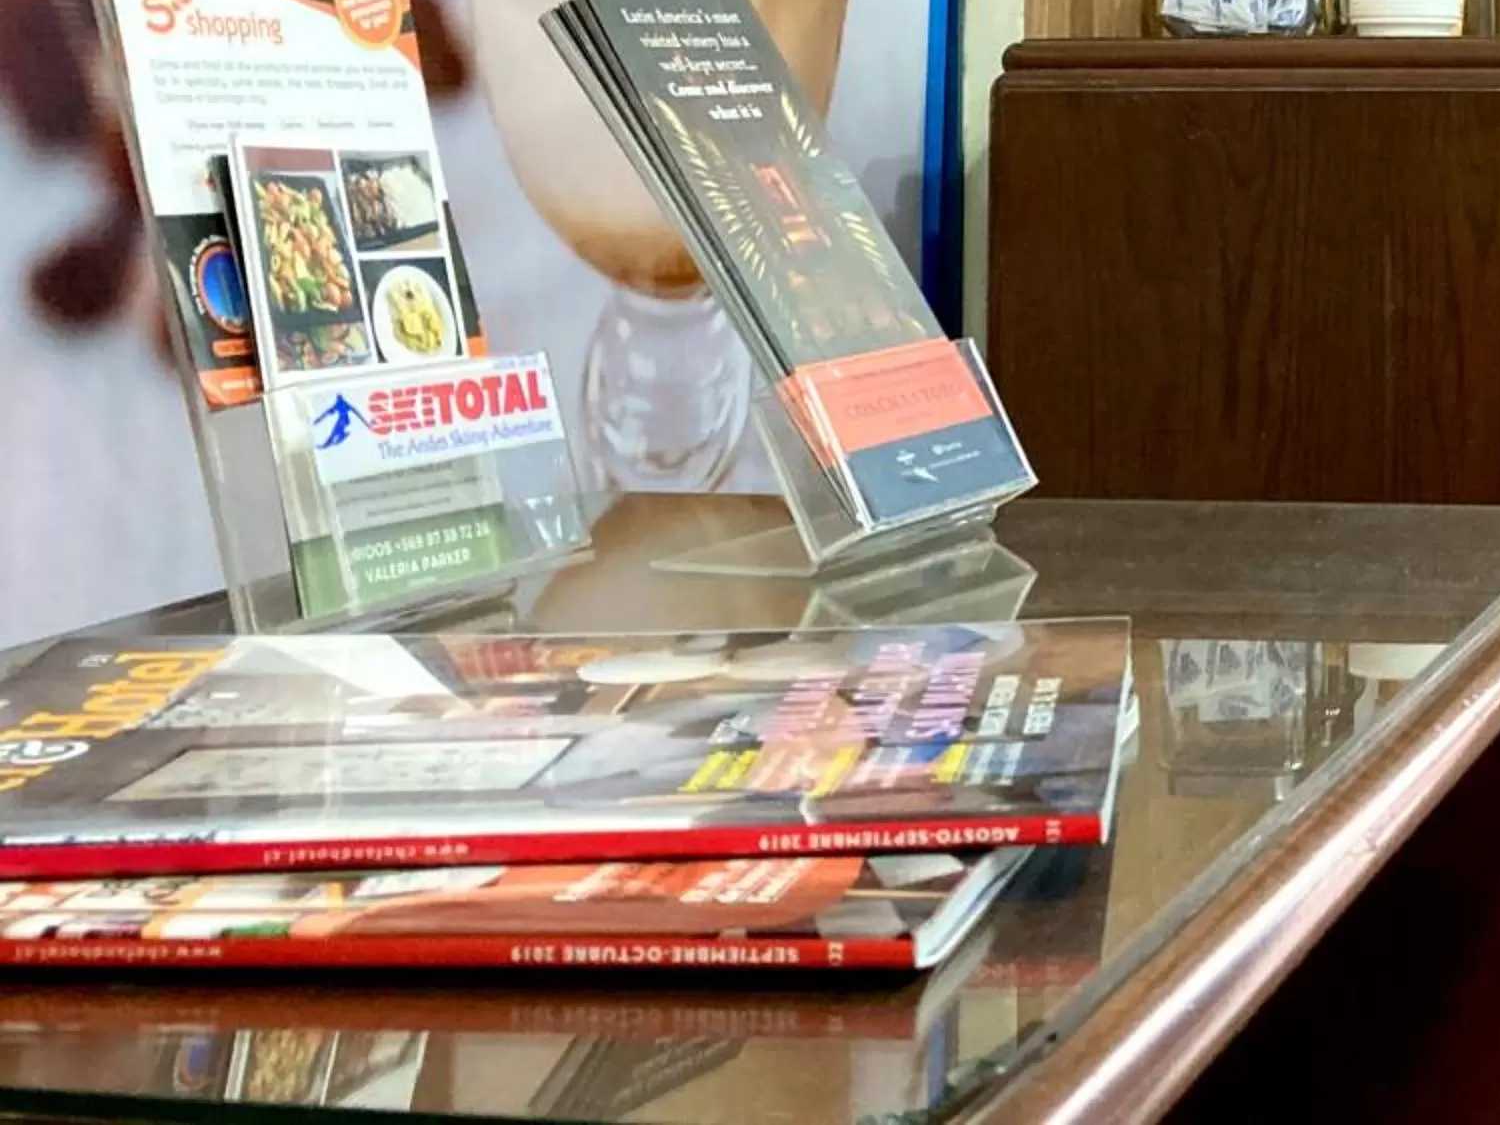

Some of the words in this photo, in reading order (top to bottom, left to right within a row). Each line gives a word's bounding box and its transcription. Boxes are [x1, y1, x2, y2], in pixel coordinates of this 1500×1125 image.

[186, 7, 284, 45] shopping
[668, 82, 704, 97] Come
[704, 81, 728, 96] and
[378, 440, 403, 460] The
[904, 706, 967, 741] SAN
[758, 834, 801, 852] 2019
[808, 825, 1021, 850] AGOSTO-SEPTIEMBRE
[511, 944, 554, 963] 2019
[562, 944, 800, 965] SEPTIEMBRE-OCTUBRE
